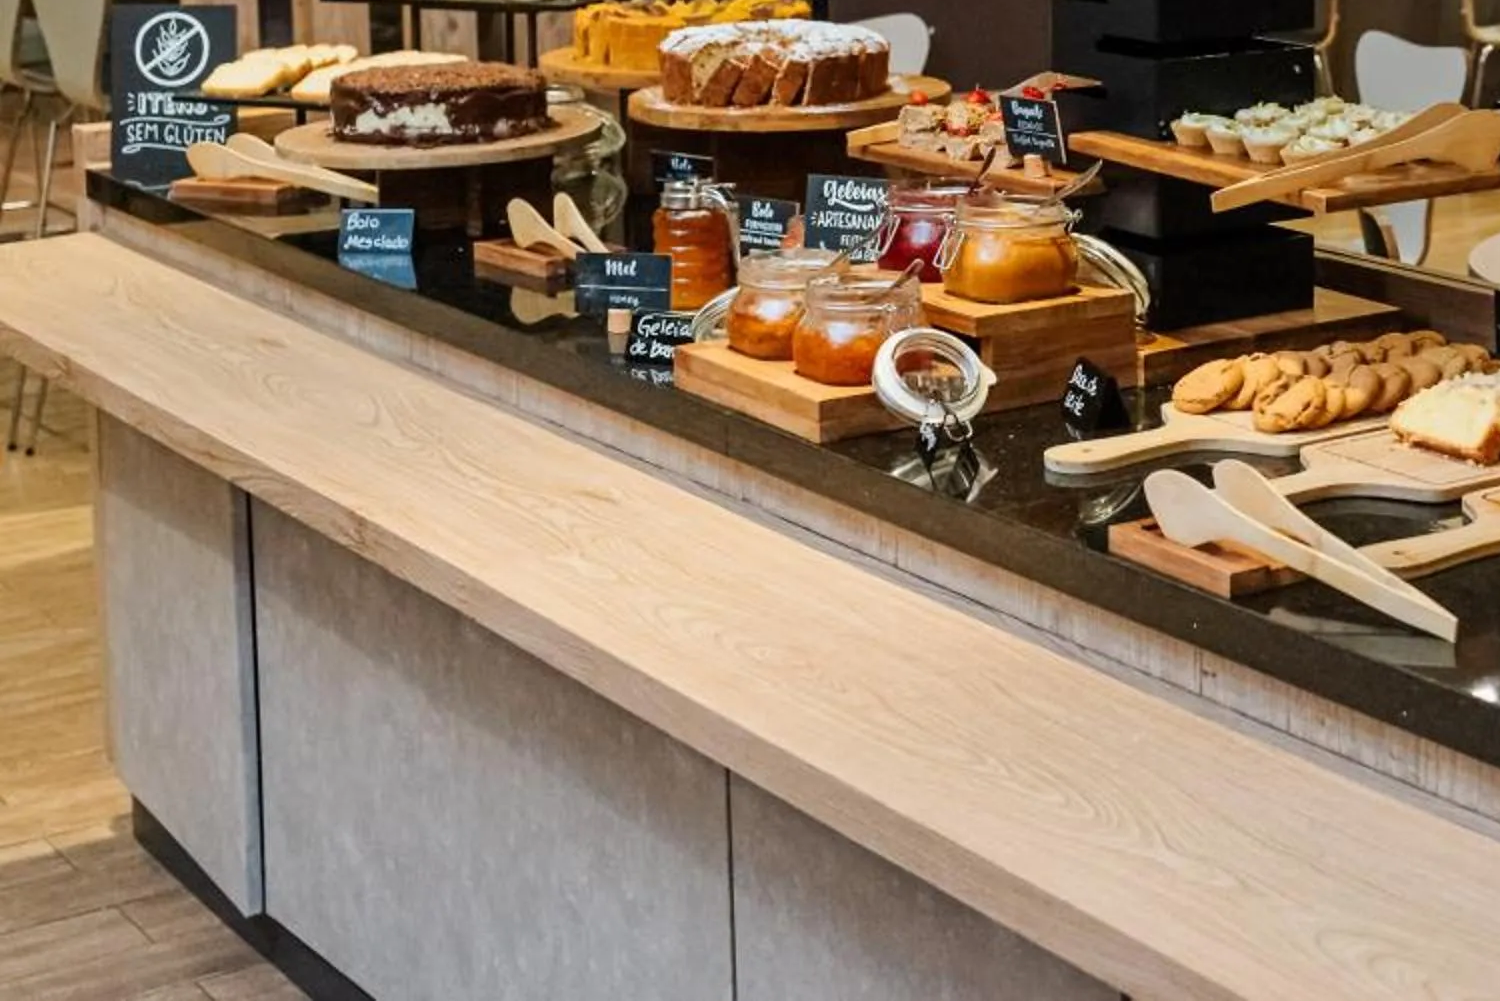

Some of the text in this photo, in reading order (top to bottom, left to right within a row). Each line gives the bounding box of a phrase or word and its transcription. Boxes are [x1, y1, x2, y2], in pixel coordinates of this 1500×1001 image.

[126, 122, 159, 144] SEM
[347, 212, 380, 231] Bolo
[344, 234, 409, 250] Mesclado
[604, 259, 638, 277] Mel
[637, 314, 693, 338] Geleia
[629, 338, 648, 357] de
